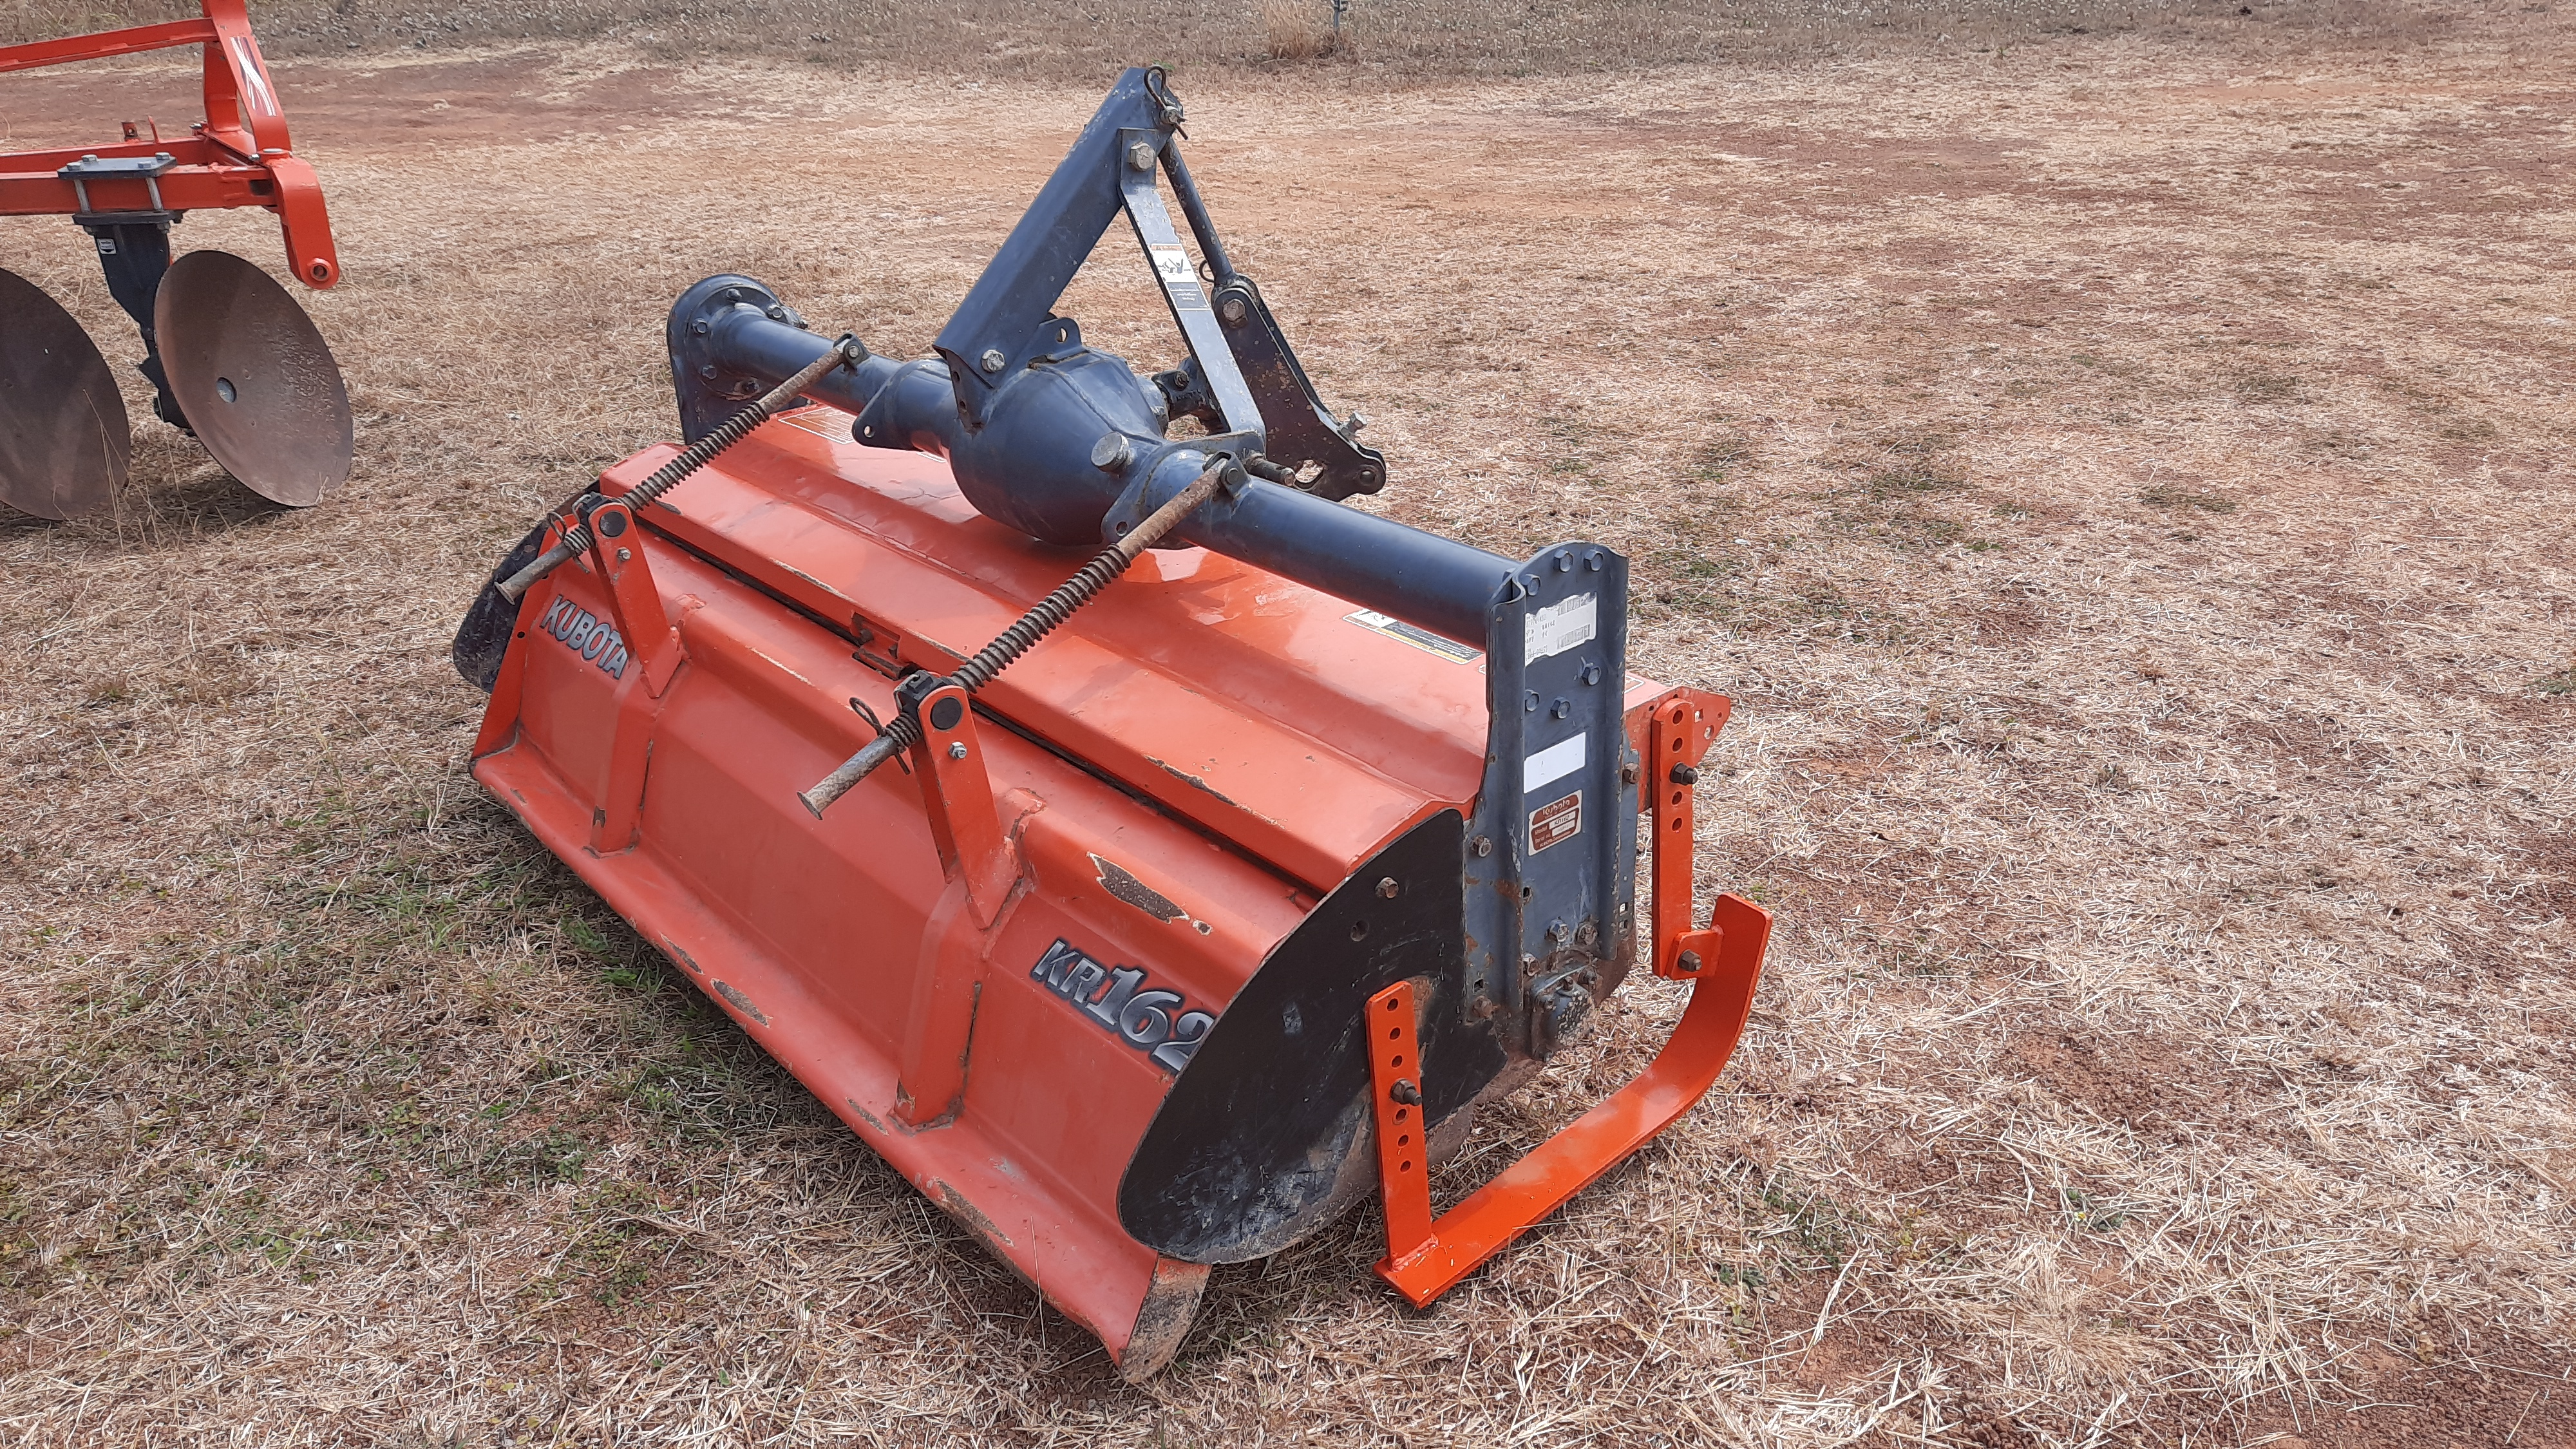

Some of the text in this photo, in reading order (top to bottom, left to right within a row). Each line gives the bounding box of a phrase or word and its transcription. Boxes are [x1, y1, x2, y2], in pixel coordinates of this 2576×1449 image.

[539, 594, 629, 680] KUBOTA
[1542, 799, 1570, 815] Kubota
[1031, 938, 1216, 1075] KR162
